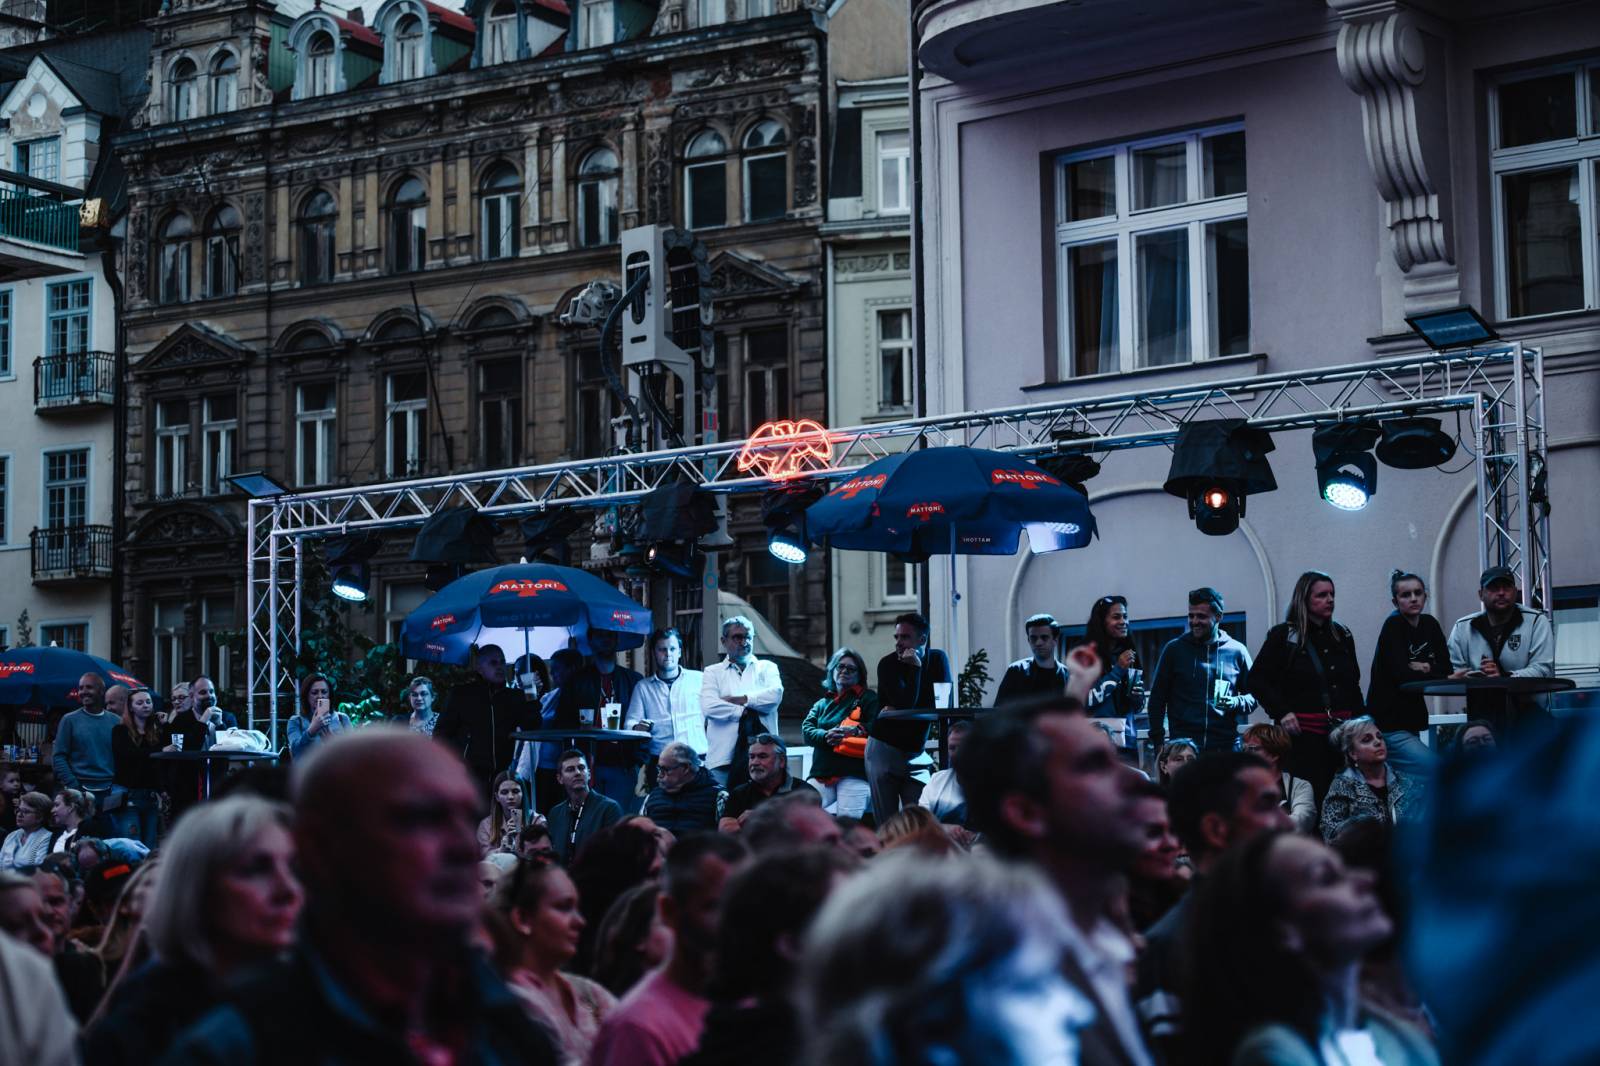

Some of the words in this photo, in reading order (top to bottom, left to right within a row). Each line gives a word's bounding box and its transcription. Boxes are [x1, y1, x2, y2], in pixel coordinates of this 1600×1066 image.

[994, 473, 1048, 482] MATTONI
[840, 478, 884, 491] MATTONI
[910, 505, 941, 513] MATTONI
